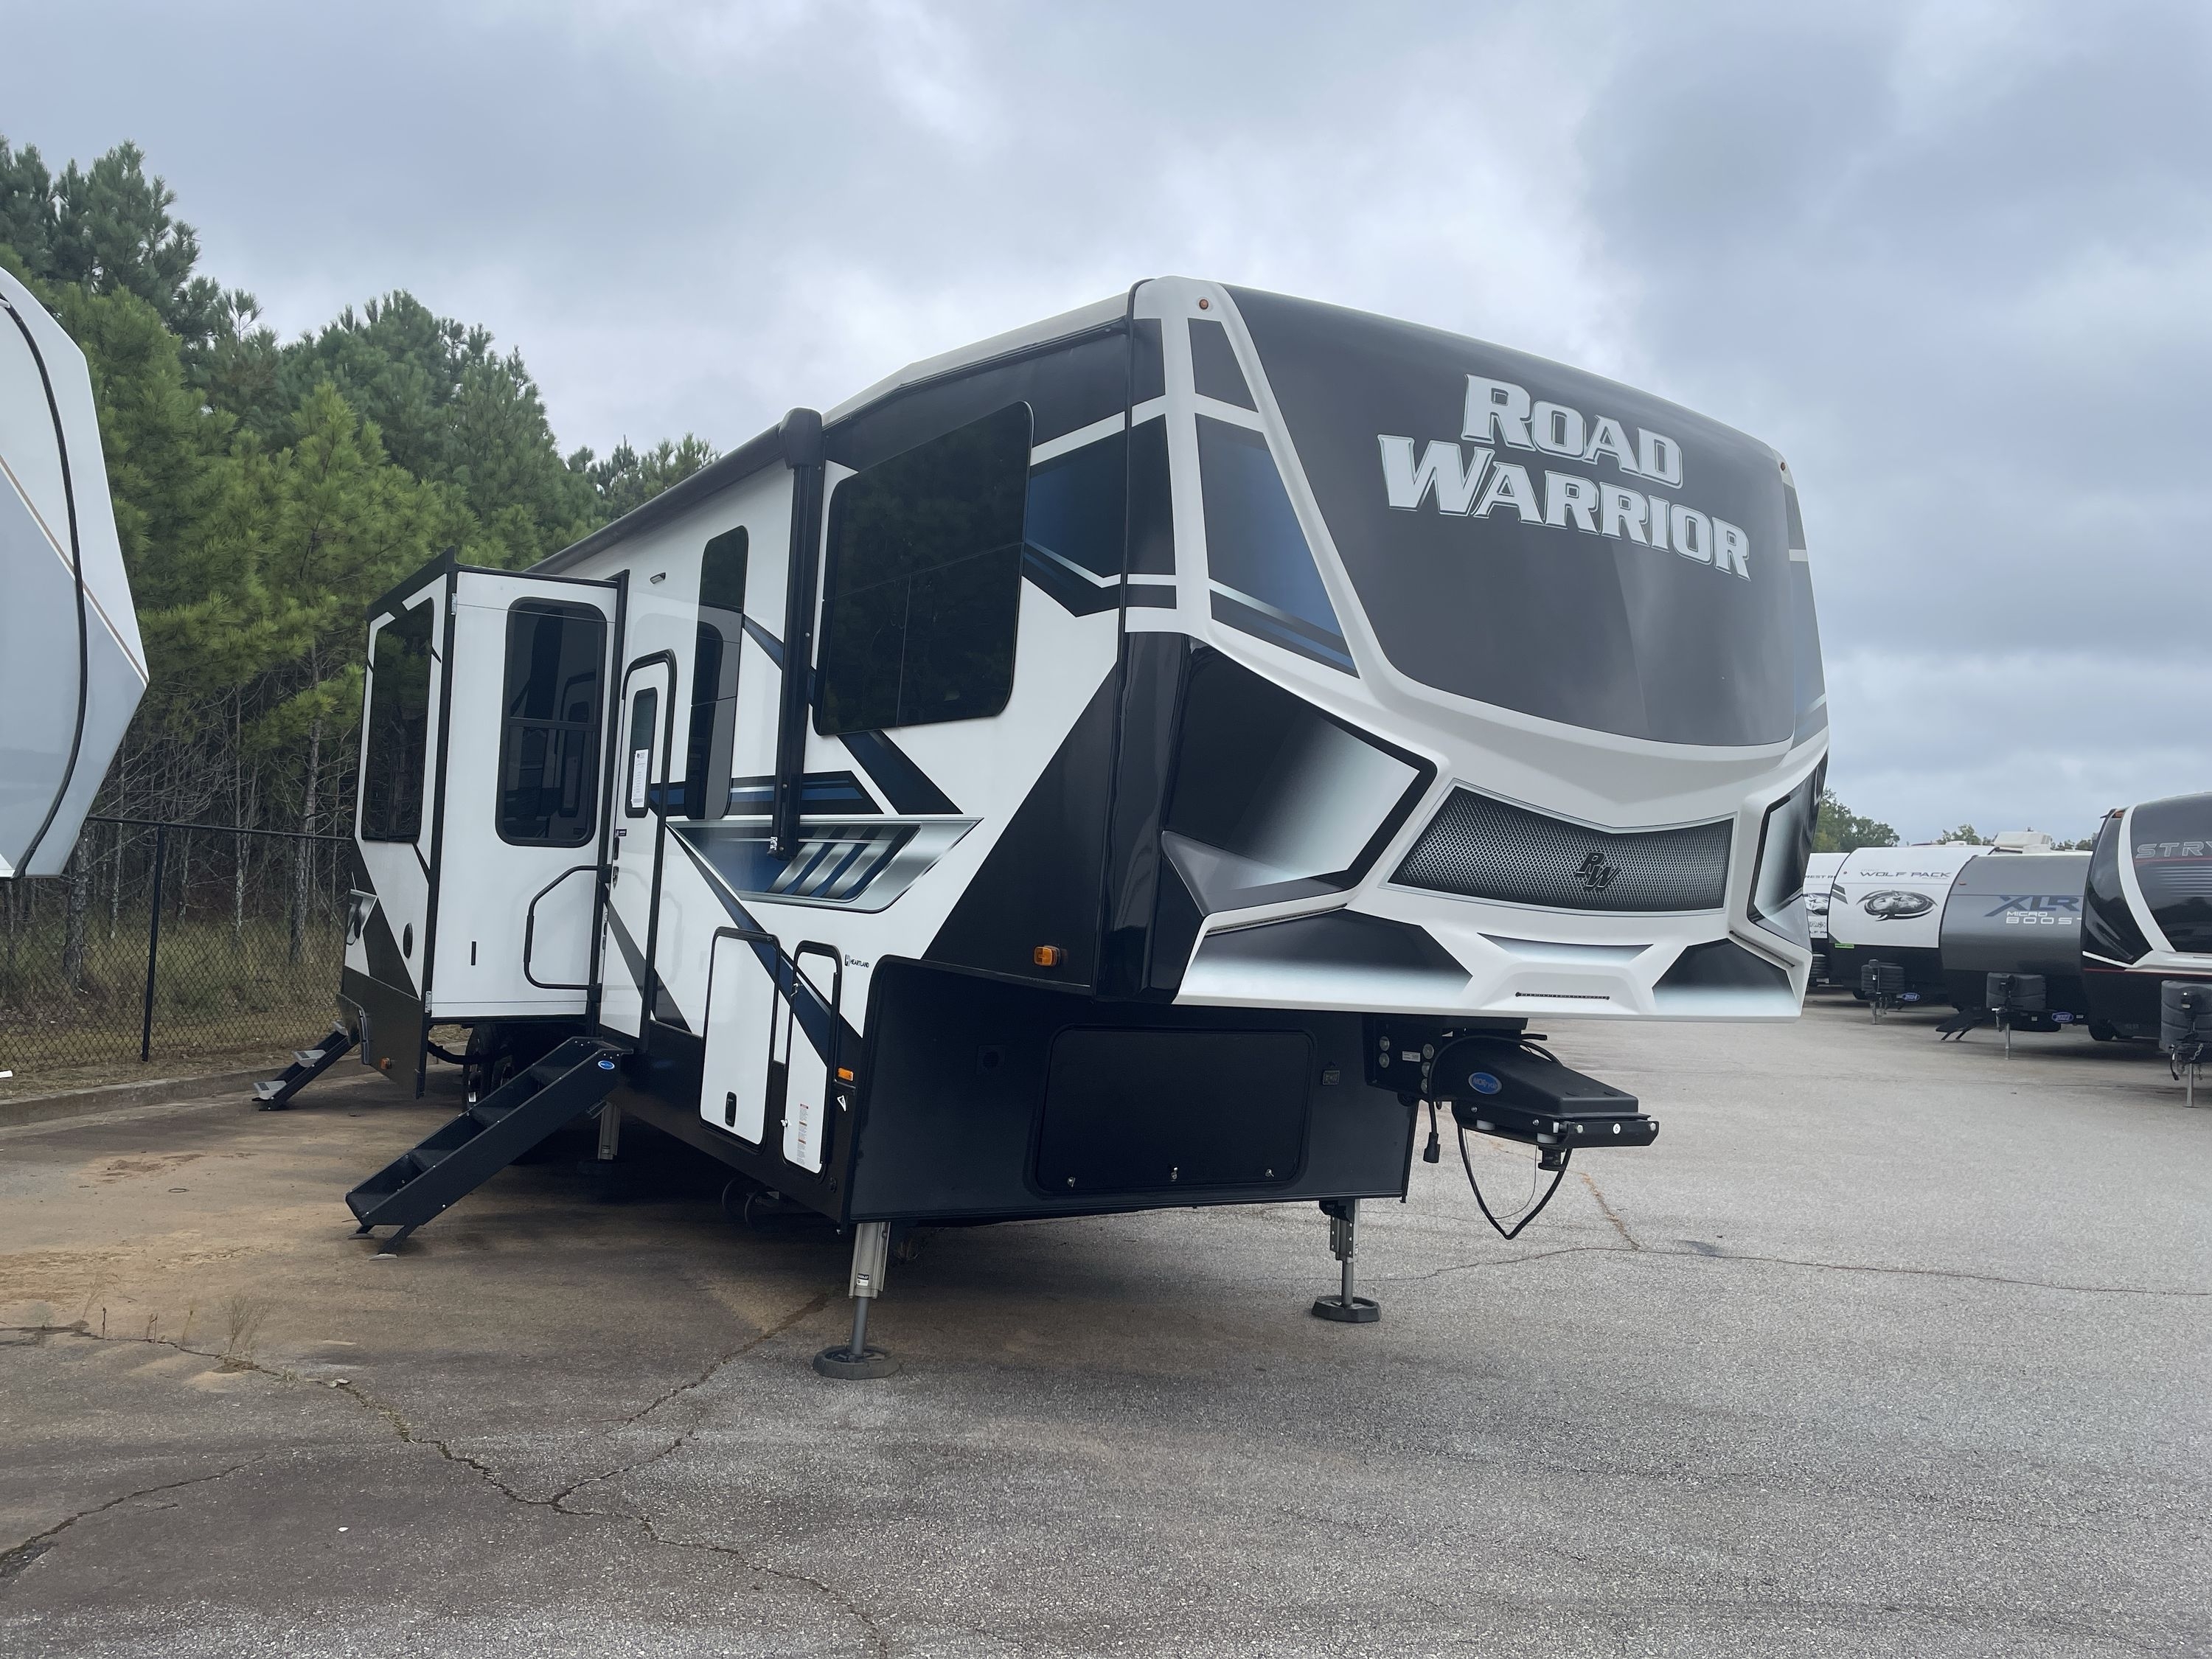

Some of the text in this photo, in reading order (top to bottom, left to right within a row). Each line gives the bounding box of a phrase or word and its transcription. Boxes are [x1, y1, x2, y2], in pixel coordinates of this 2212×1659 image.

[1461, 374, 1683, 489] ROAD
[1377, 434, 1751, 581] WARRIOR
[1983, 895, 2080, 917] XLR
